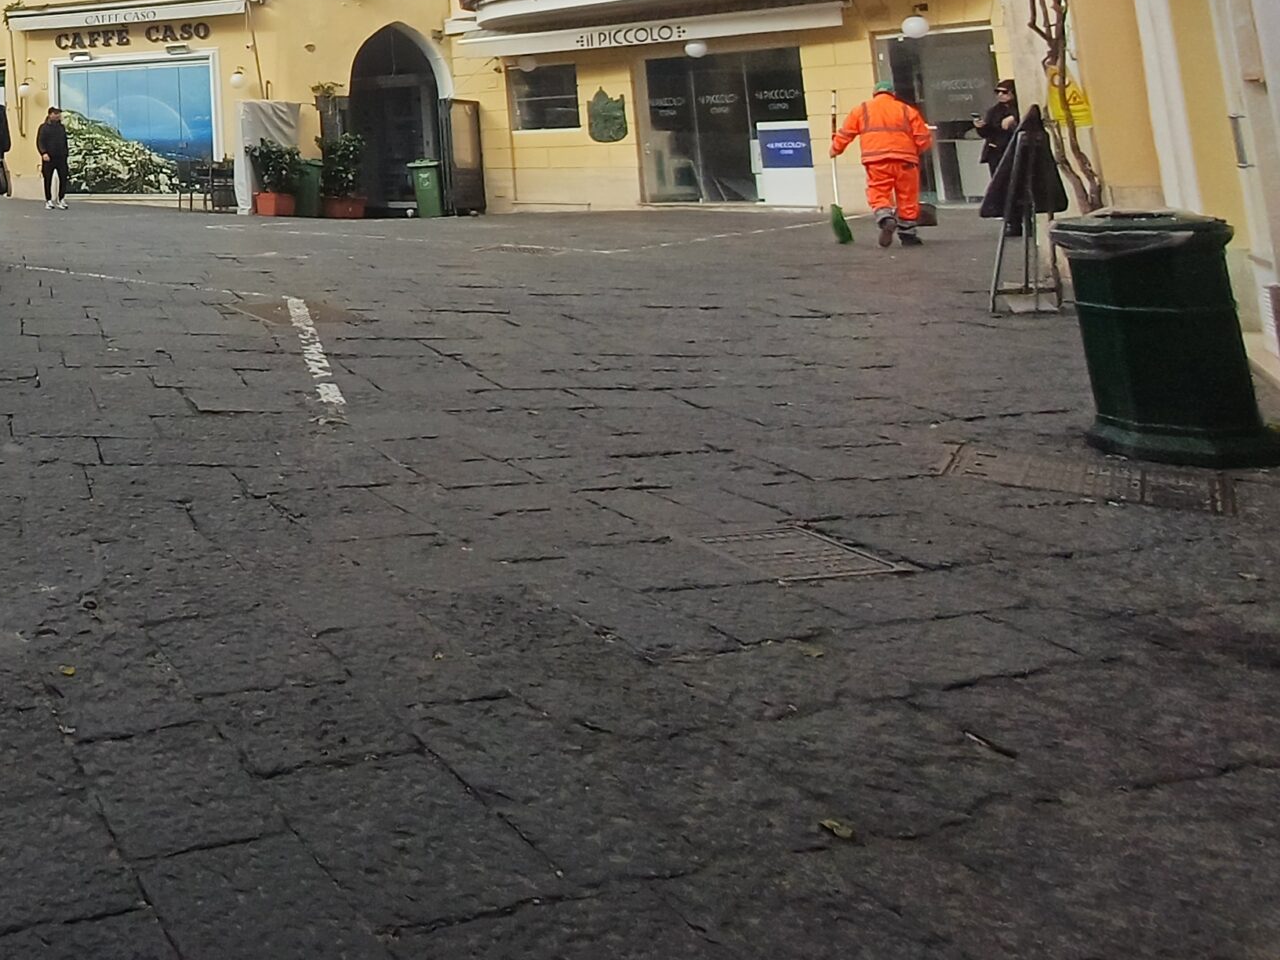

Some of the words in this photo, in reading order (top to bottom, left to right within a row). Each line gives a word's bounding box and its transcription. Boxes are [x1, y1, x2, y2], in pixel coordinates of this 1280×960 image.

[123, 10, 157, 21] CASO
[55, 23, 131, 50] CAFFÈ
[145, 22, 211, 43] CASO
[598, 25, 673, 46] PICCOLO
